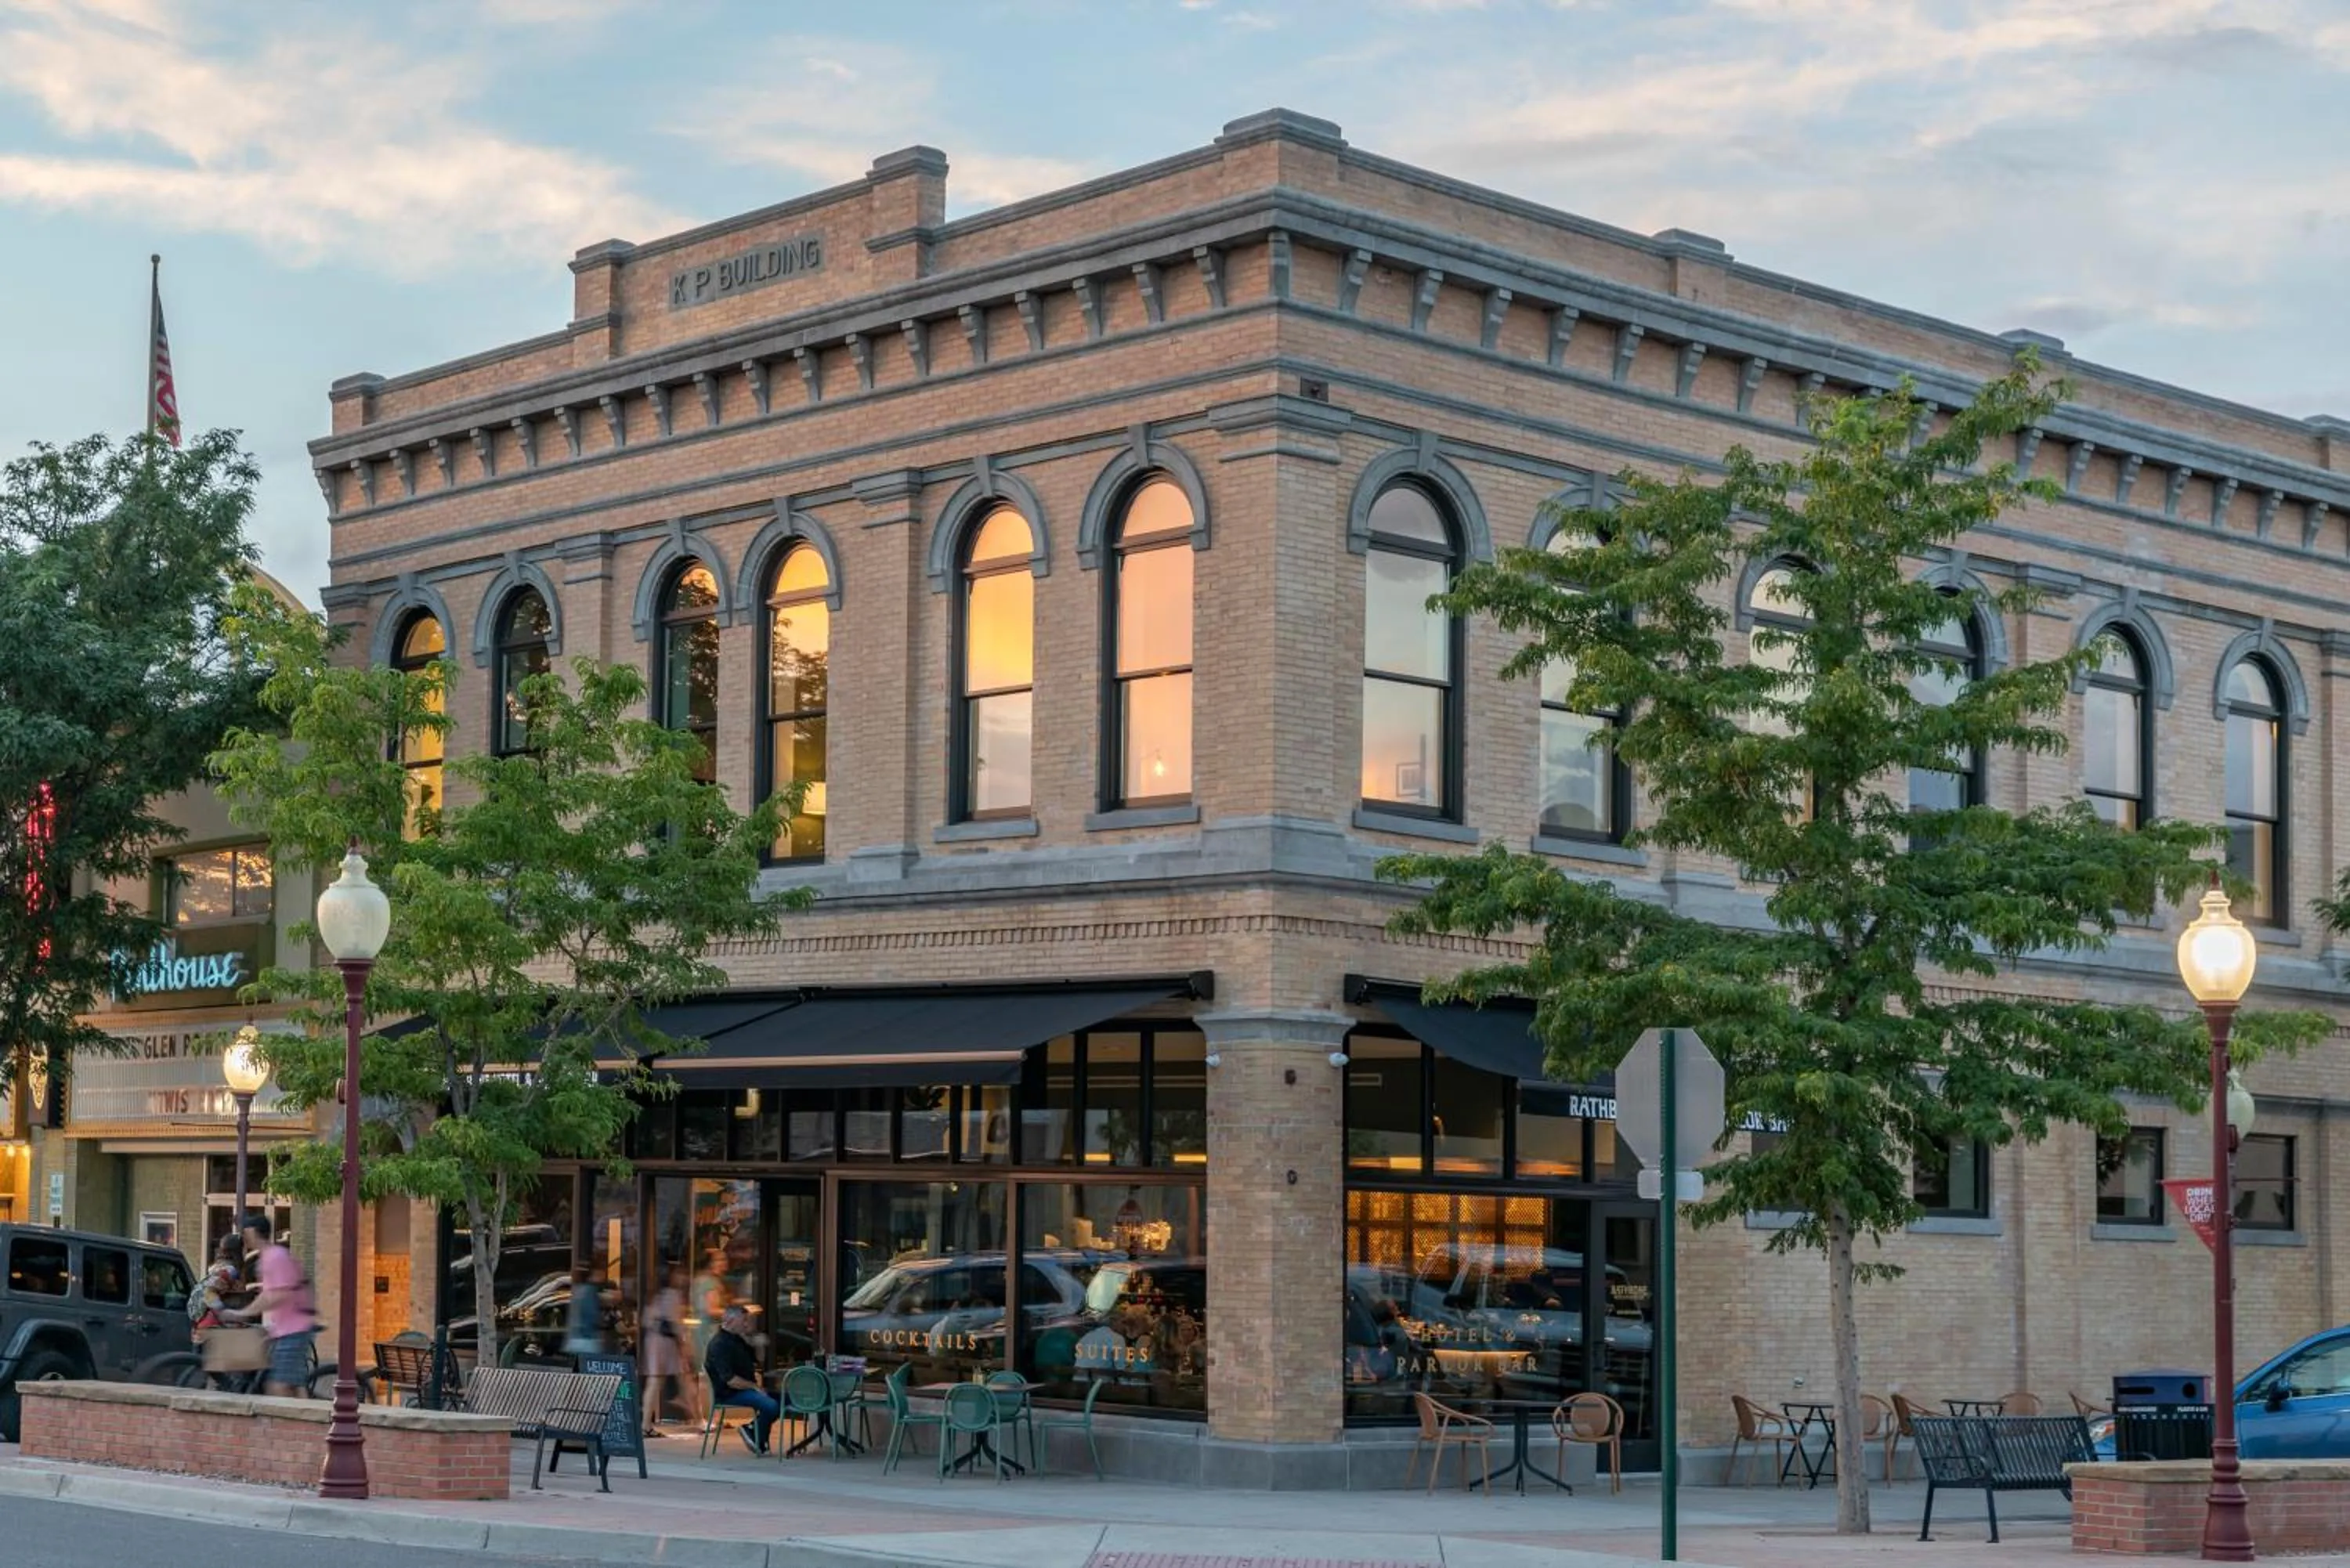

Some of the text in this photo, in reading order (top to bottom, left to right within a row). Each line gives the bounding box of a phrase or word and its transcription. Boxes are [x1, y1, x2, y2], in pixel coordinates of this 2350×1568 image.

[674, 239, 819, 304] K P BUILDING
[144, 1034, 177, 1059] GLEN
[1570, 1096, 1617, 1119] RATHB
[2187, 1187, 2214, 1196] DRIN
[2184, 1205, 2216, 1214] LOCAL
[870, 1329, 977, 1350] COCKTAILS
[1421, 1326, 1492, 1342] HOTEL
[1075, 1342, 1151, 1363] SUITES
[1397, 1356, 1538, 1374] PARLOR BAR
